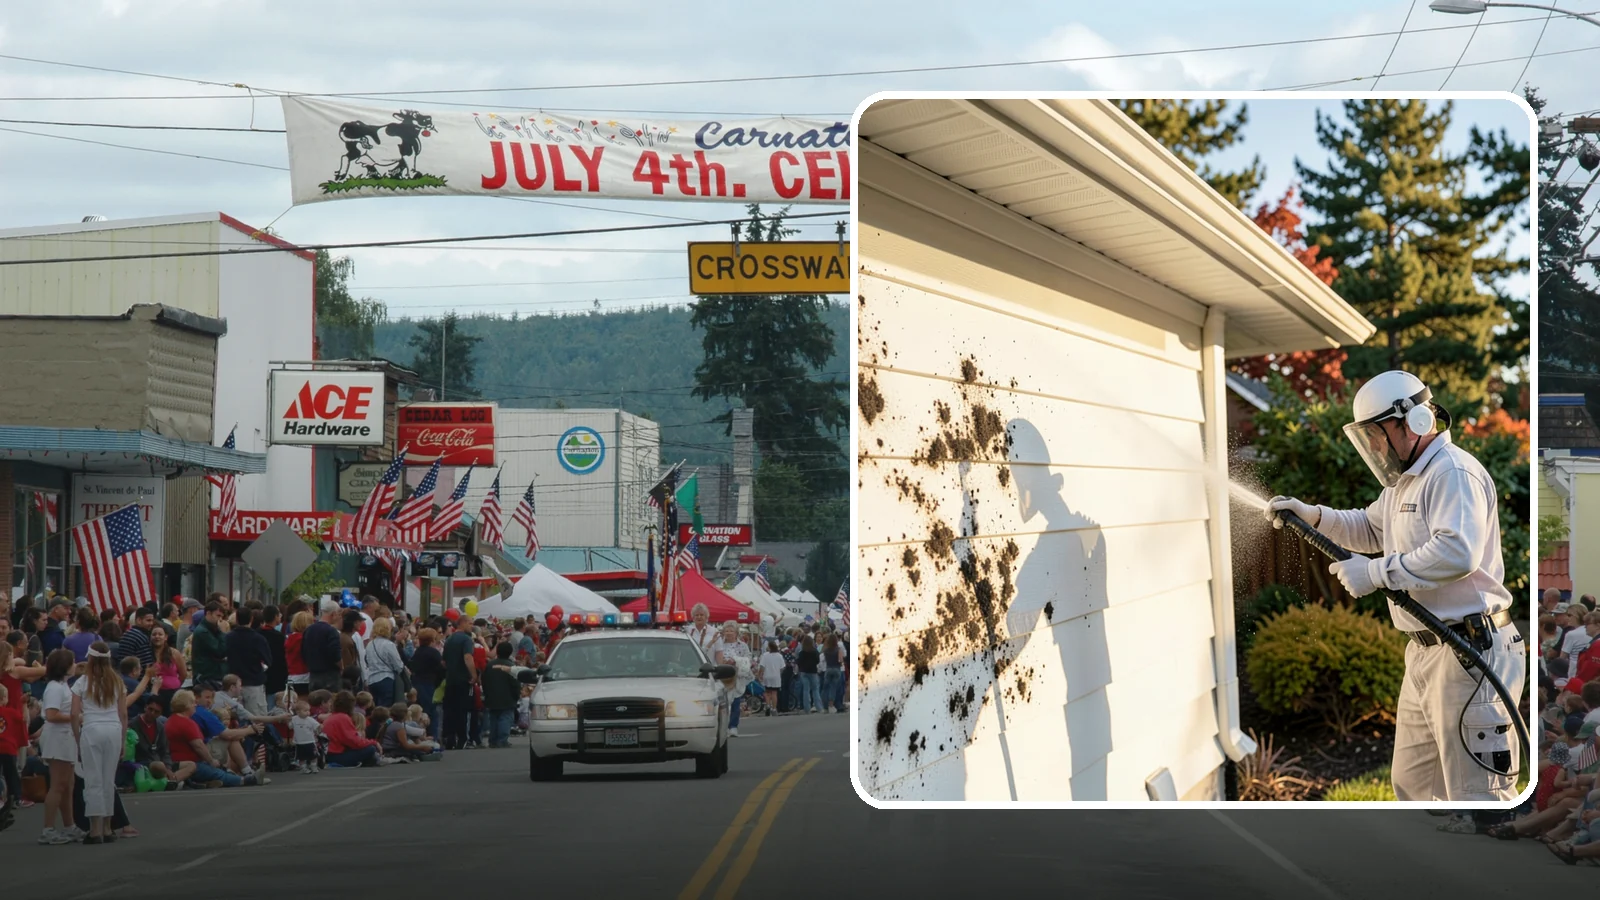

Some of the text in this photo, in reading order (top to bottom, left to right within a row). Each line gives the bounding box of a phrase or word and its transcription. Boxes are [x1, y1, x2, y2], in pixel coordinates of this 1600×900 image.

[481, 141, 604, 193] JULY
[633, 150, 746, 198] 4th.
[697, 253, 850, 280] CROSSWA
[283, 380, 373, 420] ACE
[405, 409, 485, 422] CEDAR LOG
[283, 421, 371, 437] Hardware
[416, 428, 477, 447] Coca-Cola
[353, 467, 385, 480] Simpl
[83, 486, 155, 496] St. Vincent de Paul
[688, 526, 741, 535] CRNATION
[699, 535, 730, 544] GLASS
